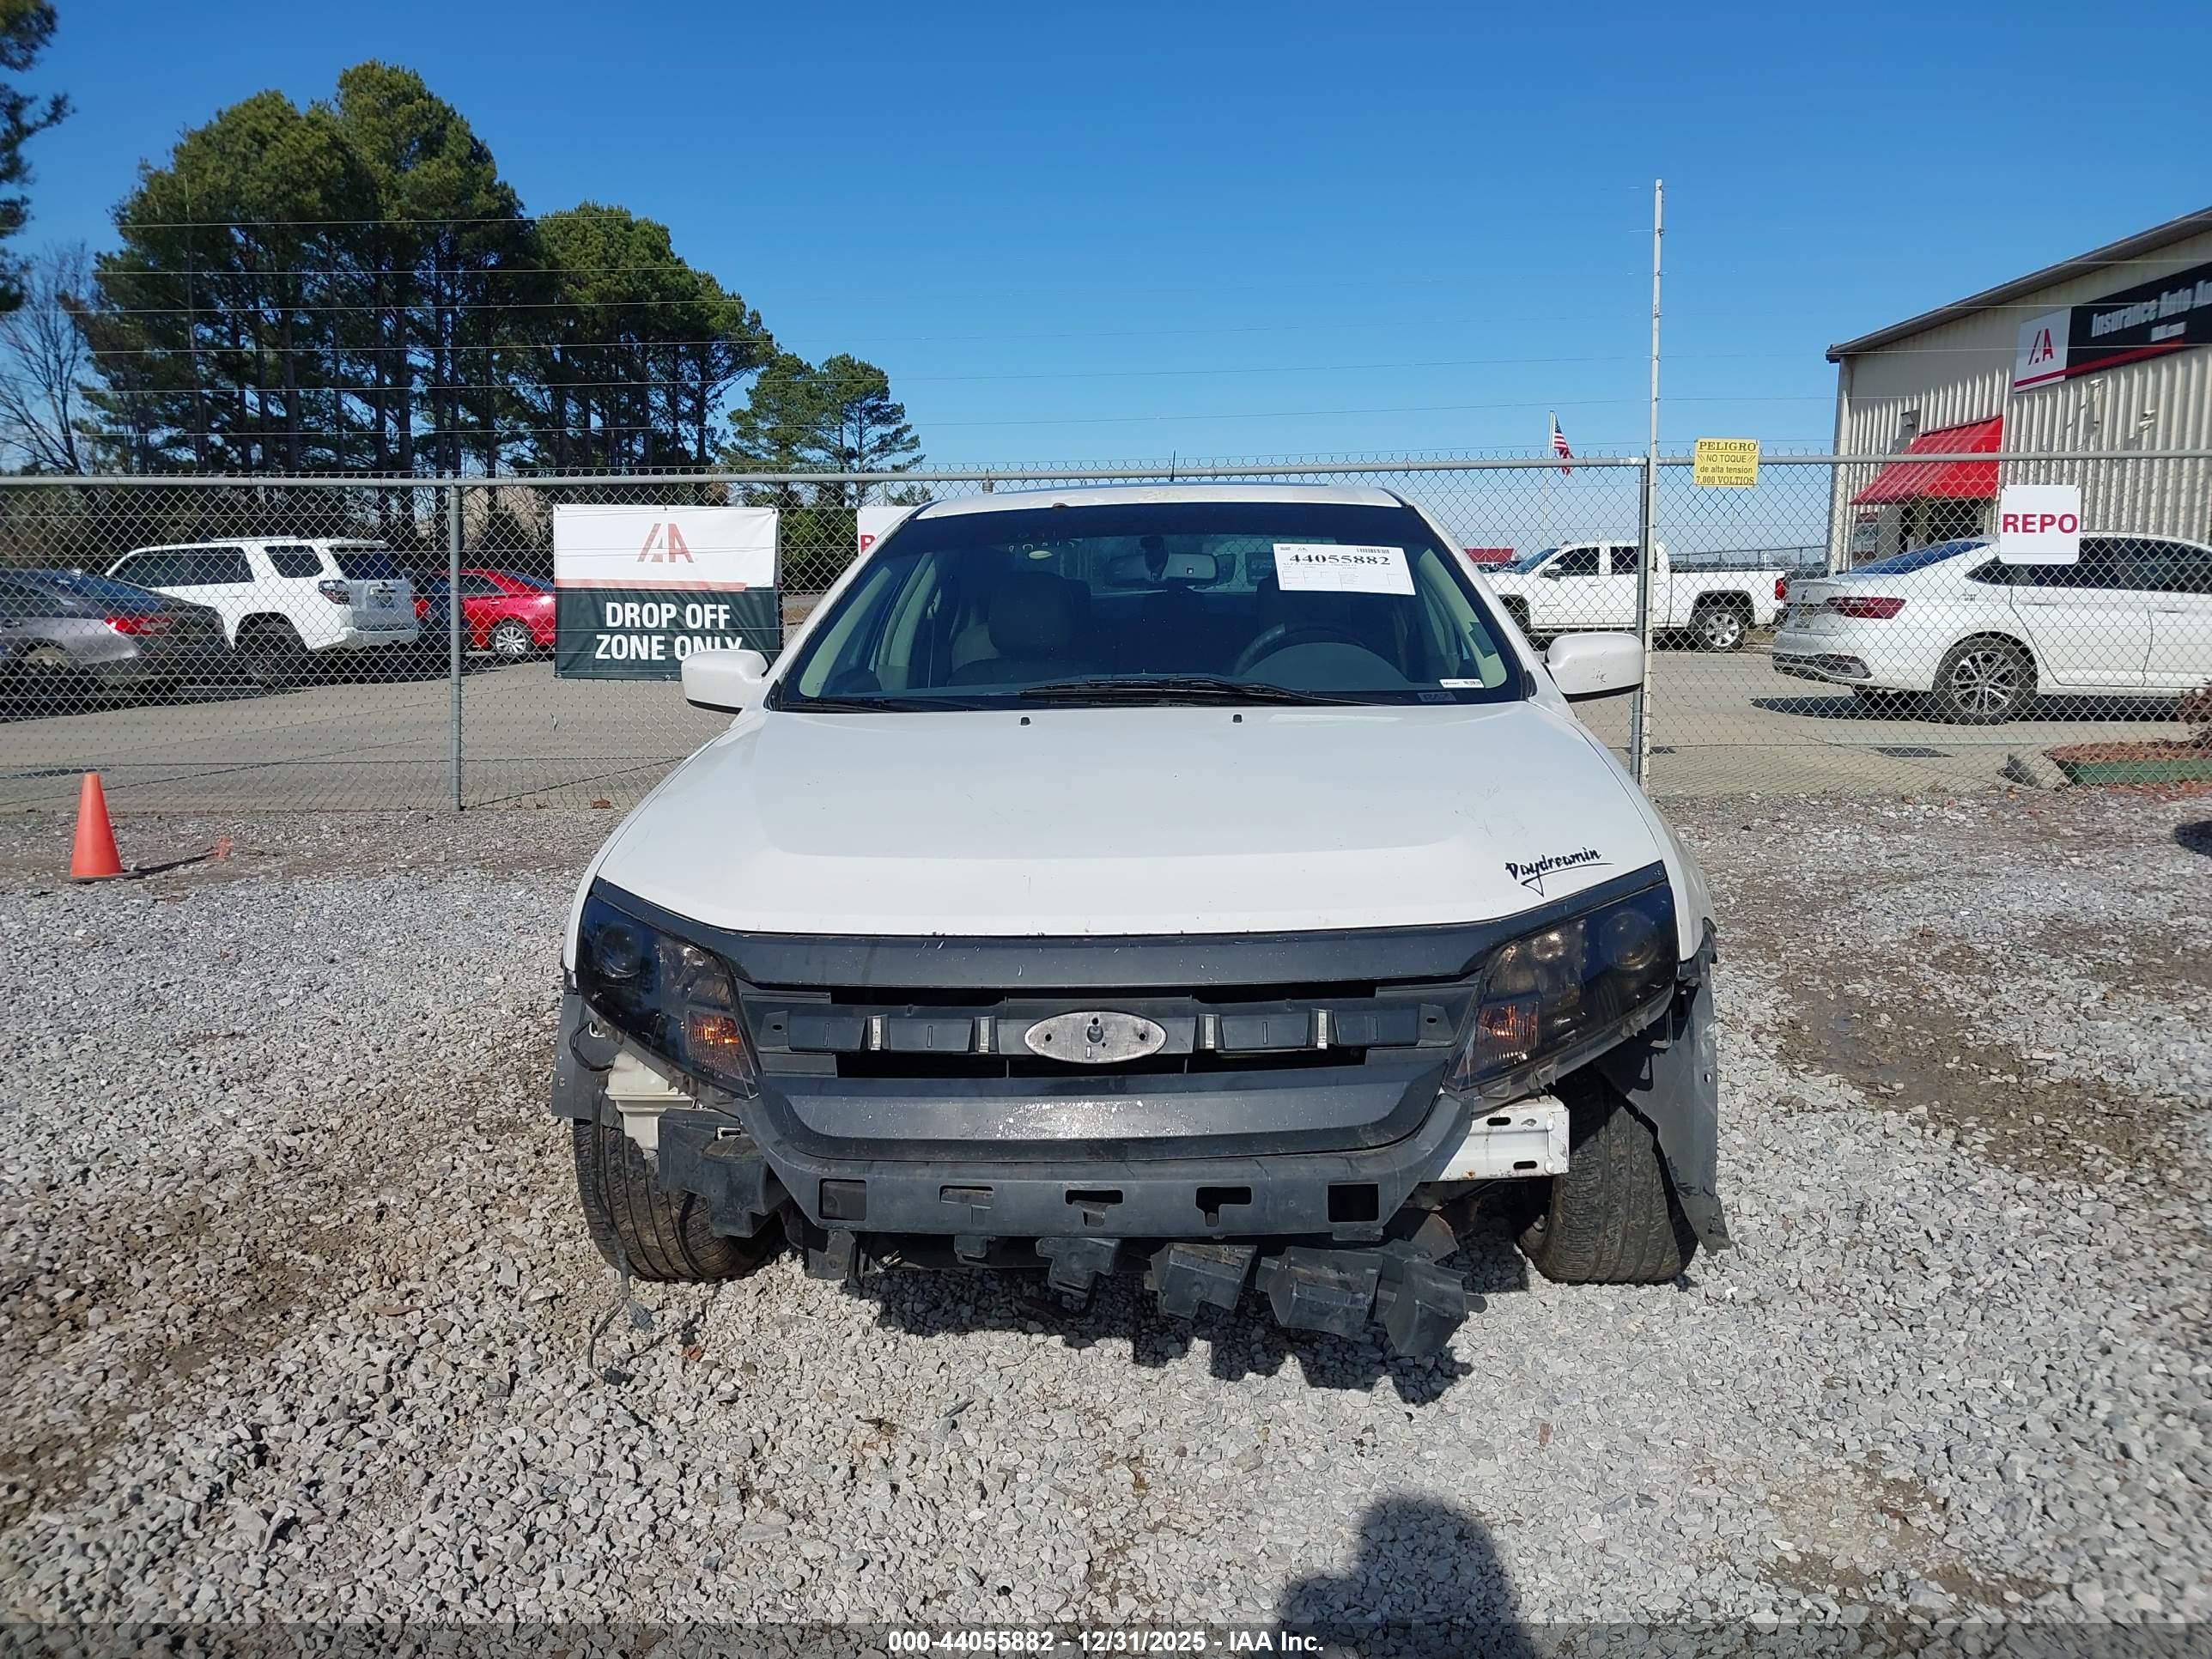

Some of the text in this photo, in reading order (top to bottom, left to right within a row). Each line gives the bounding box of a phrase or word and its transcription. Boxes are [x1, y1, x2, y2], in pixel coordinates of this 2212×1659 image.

[1698, 441, 1757, 452] PELIGRO
[1706, 453, 1747, 463] NO TOQUE
[1699, 465, 1753, 474] de alta tension
[1717, 476, 1754, 485] VOLTIOS
[2002, 514, 2078, 534] REPO
[1289, 554, 1391, 566] 44055882
[605, 602, 731, 629] DROP OFF
[594, 634, 666, 660] ZONE
